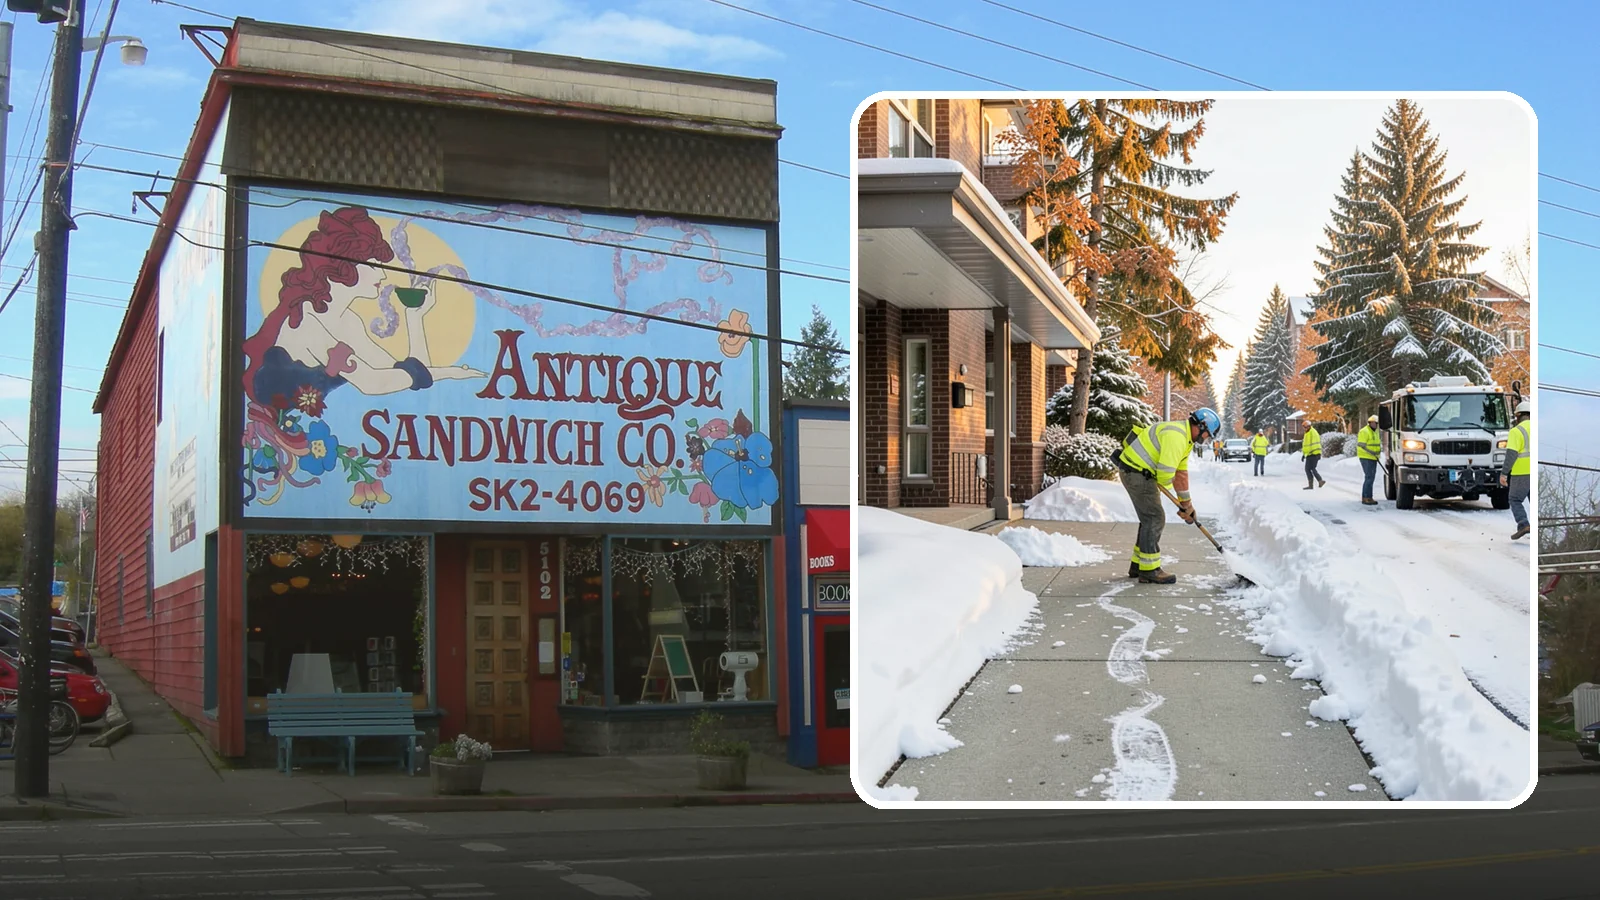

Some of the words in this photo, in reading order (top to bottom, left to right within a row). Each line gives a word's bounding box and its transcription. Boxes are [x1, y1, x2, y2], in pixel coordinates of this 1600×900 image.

[476, 329, 723, 420] ANTIQUE
[362, 409, 604, 467] SANDWICH
[617, 422, 685, 469] CO.
[468, 478, 646, 513] SK2-4069
[540, 542, 552, 600] 5102
[809, 555, 835, 569] BOOKS
